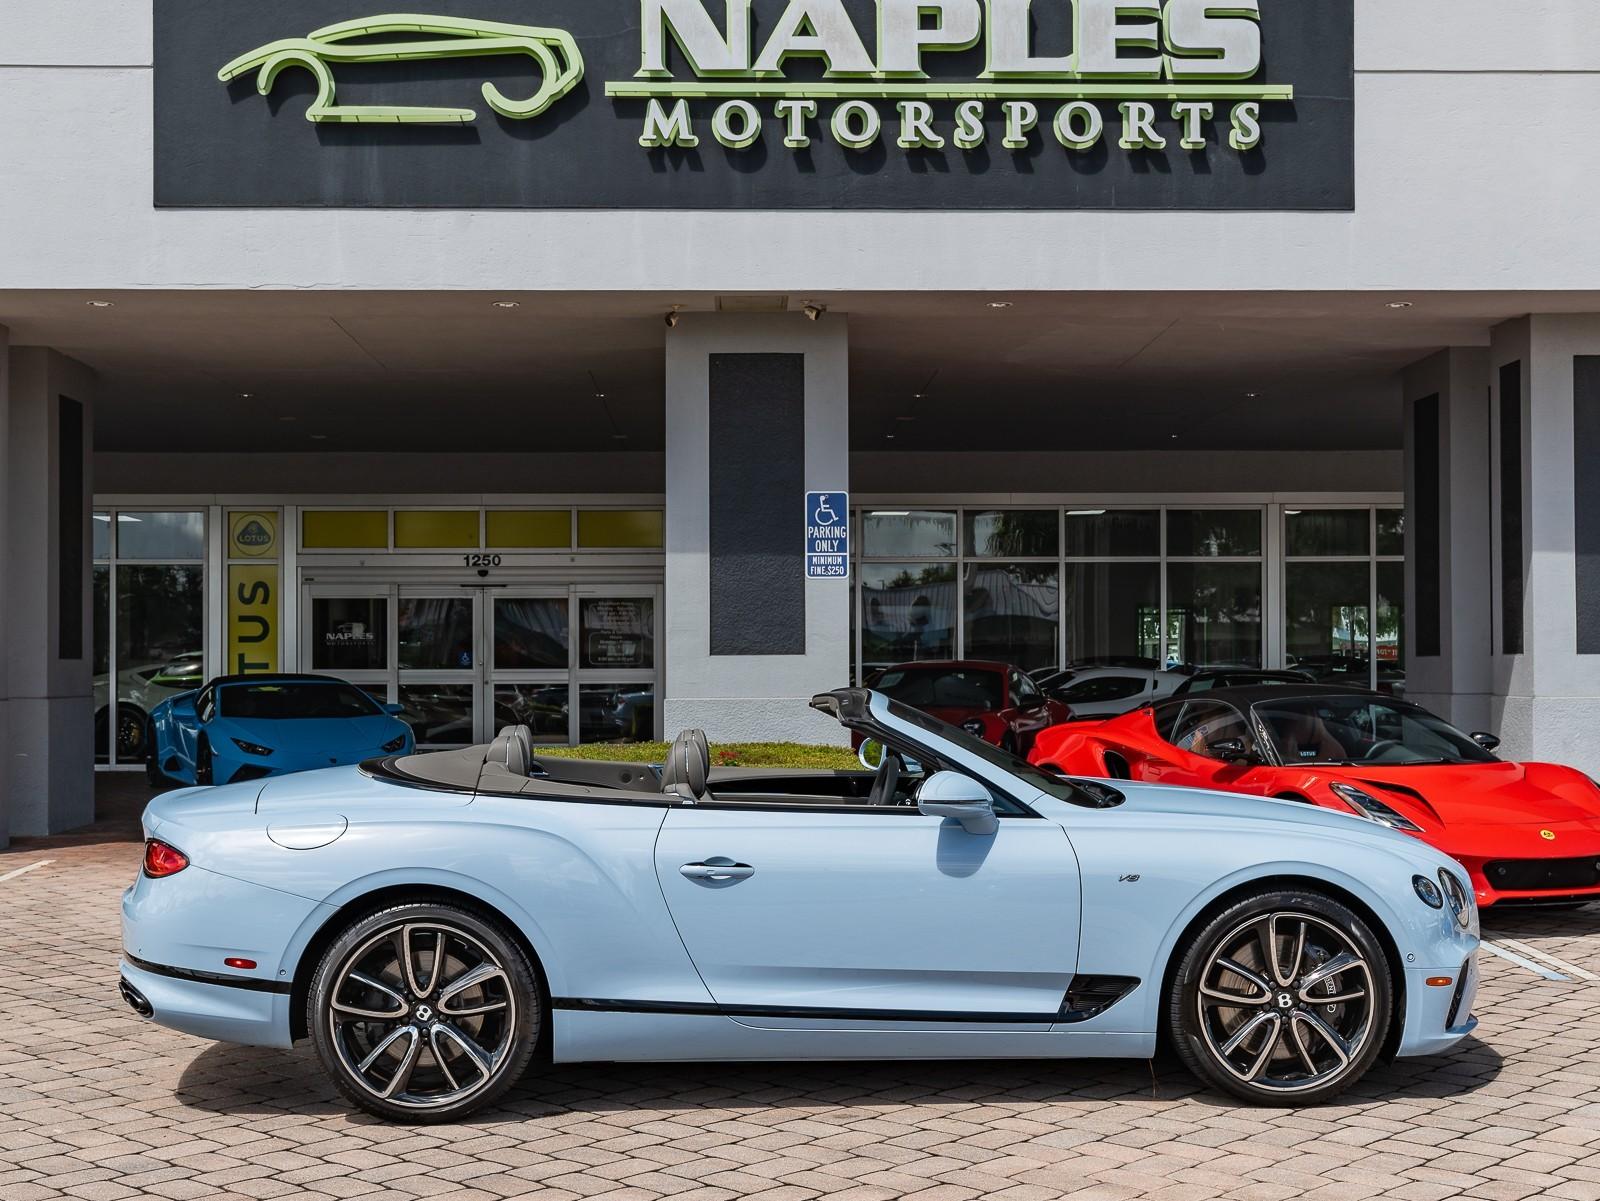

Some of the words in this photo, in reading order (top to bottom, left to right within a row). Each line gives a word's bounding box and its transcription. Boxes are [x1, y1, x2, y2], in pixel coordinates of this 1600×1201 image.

[634, 0, 1262, 79] NAPLES
[638, 99, 1262, 150] MOTORSPORTS
[808, 526, 847, 538] PARKING
[239, 535, 269, 543] LOTUS
[815, 540, 839, 552] ONLY
[463, 554, 502, 567] 1250
[812, 556, 842, 565] MINIMUM
[810, 566, 826, 575] FINE
[827, 566, 844, 575] $250
[237, 580, 270, 675] TUS
